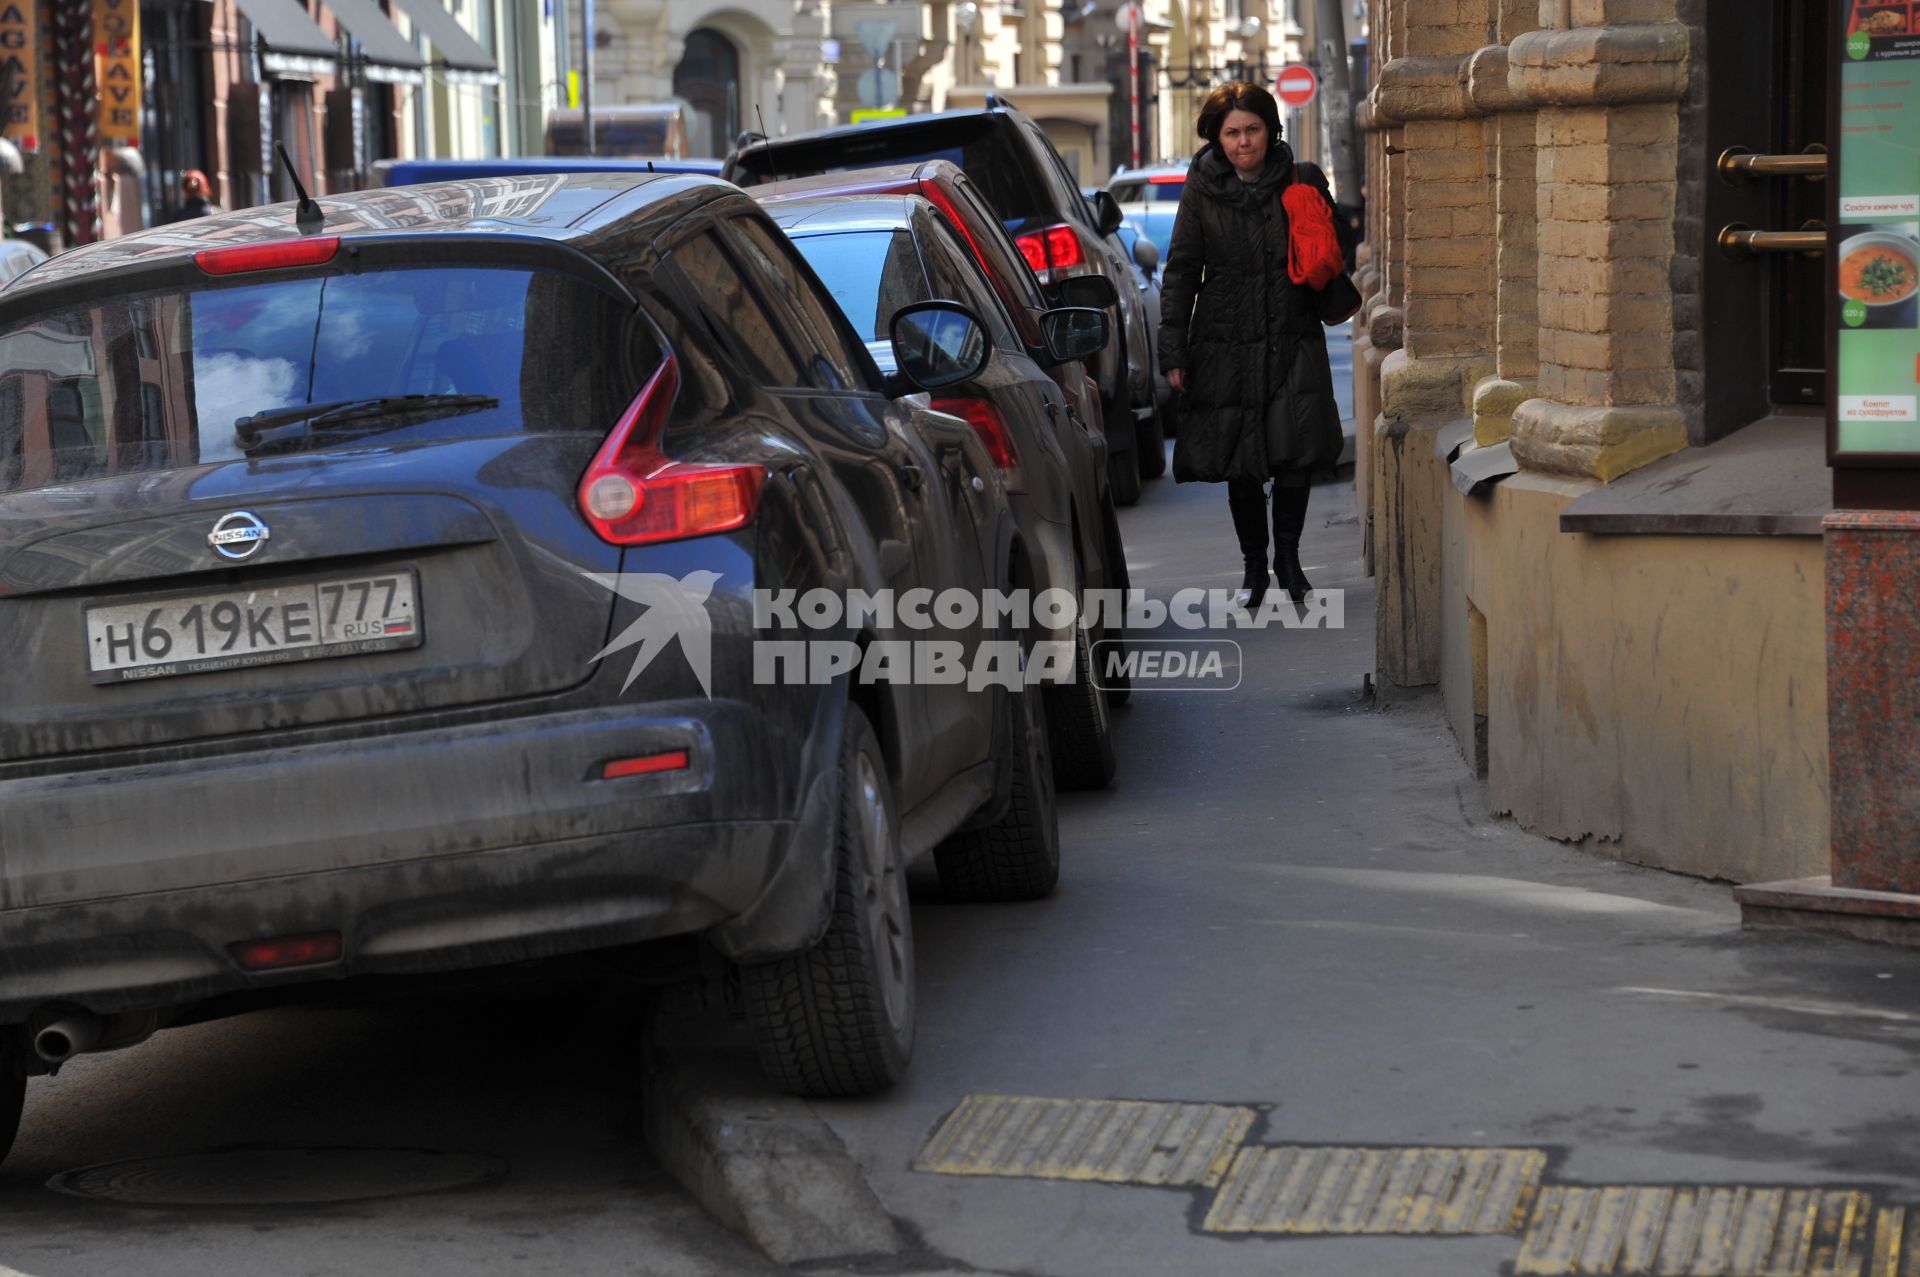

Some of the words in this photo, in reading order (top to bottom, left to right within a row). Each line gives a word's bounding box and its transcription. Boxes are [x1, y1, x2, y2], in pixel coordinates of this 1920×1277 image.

[213, 530, 260, 541] NISSAN
[321, 578, 398, 625] 777
[344, 620, 382, 637] RUS
[122, 665, 177, 680] NISSAN
[187, 657, 240, 673] ТЕХЦЕНТР
